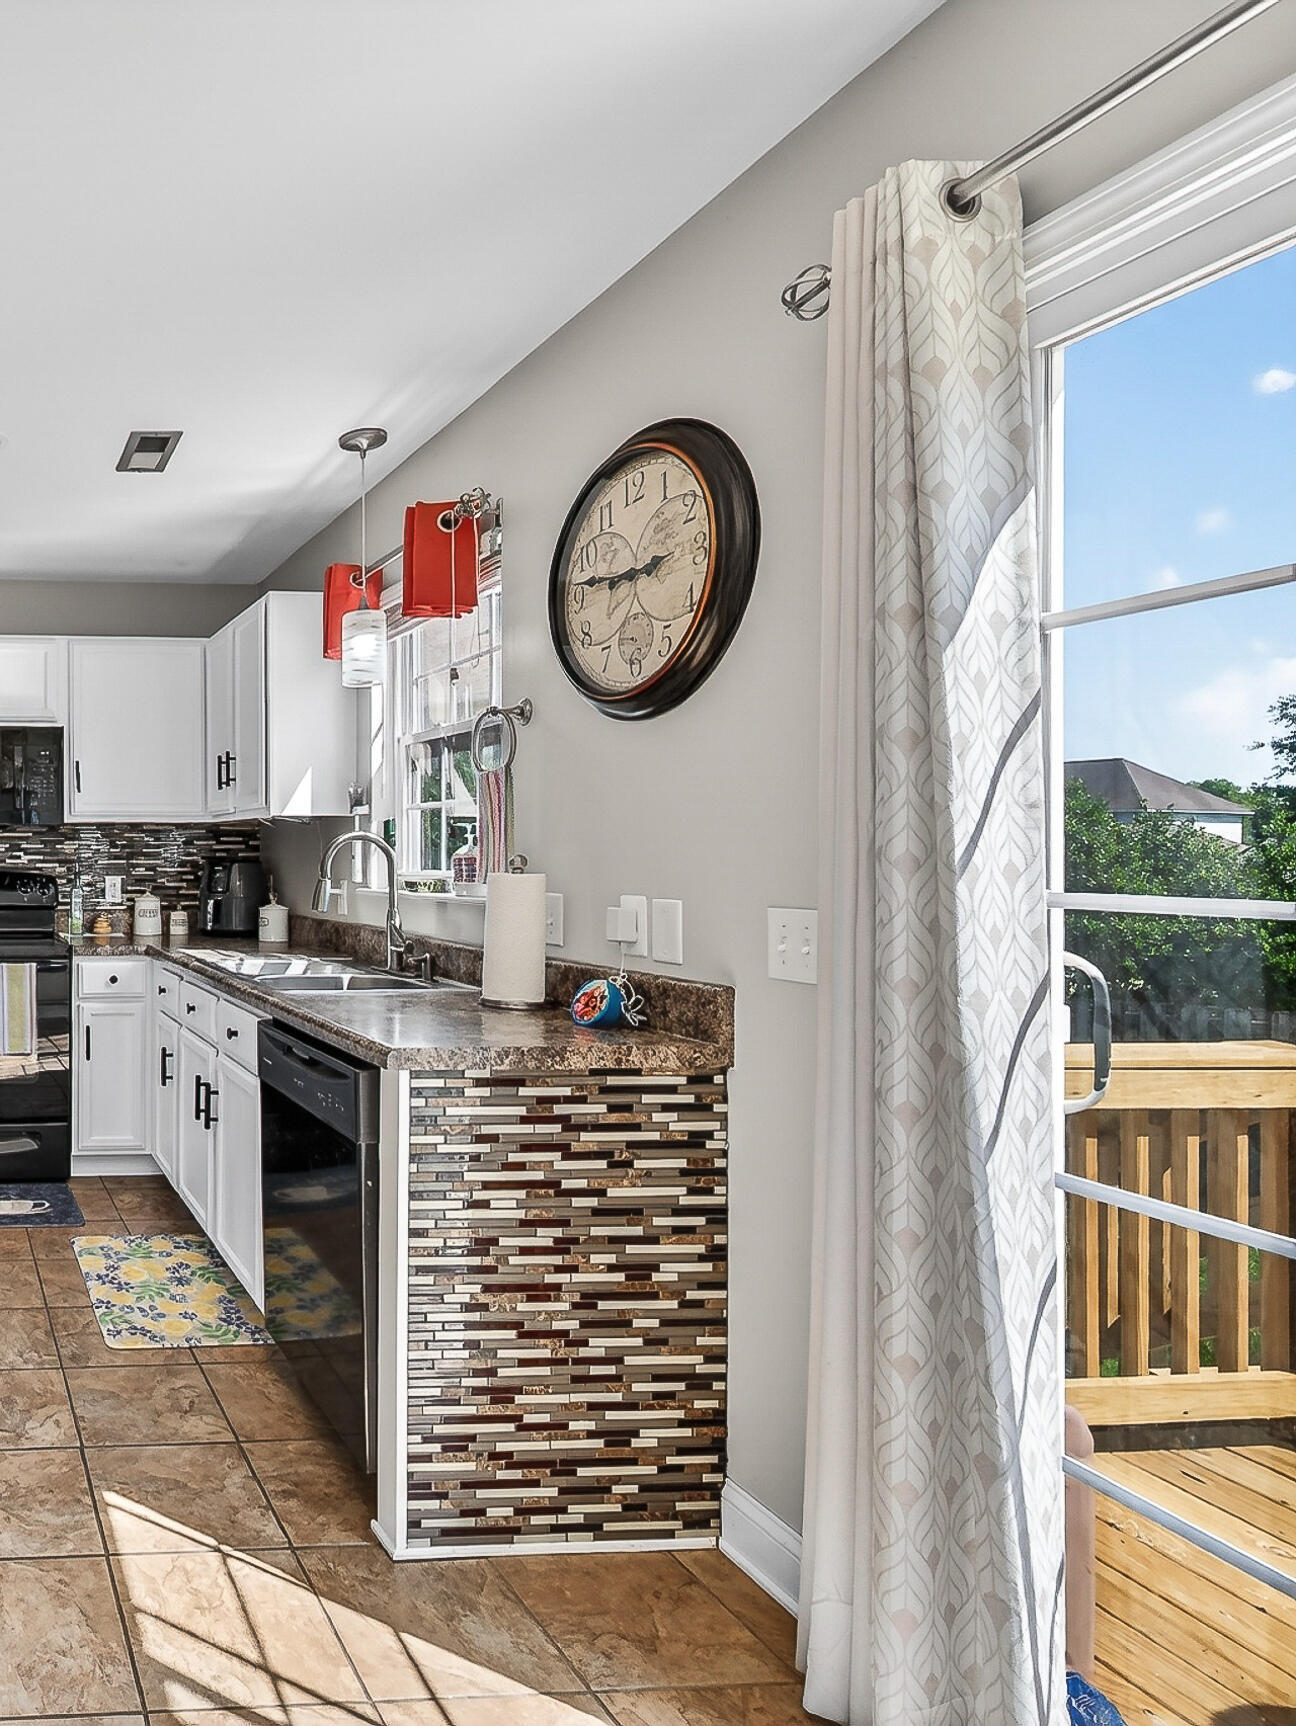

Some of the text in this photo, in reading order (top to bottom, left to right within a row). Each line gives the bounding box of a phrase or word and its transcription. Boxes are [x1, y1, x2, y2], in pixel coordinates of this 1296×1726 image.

[624, 470, 645, 509] 12
[660, 470, 669, 502] 1
[598, 500, 614, 533] 11
[682, 489, 698, 525] 2
[579, 539, 598, 573] 10
[692, 530, 708, 566] 3
[573, 585, 585, 615] 9
[682, 582, 698, 614] 4
[580, 620, 593, 650] 8
[657, 623, 672, 658] 5
[601, 644, 612, 673] 7
[629, 647, 642, 678] 6
